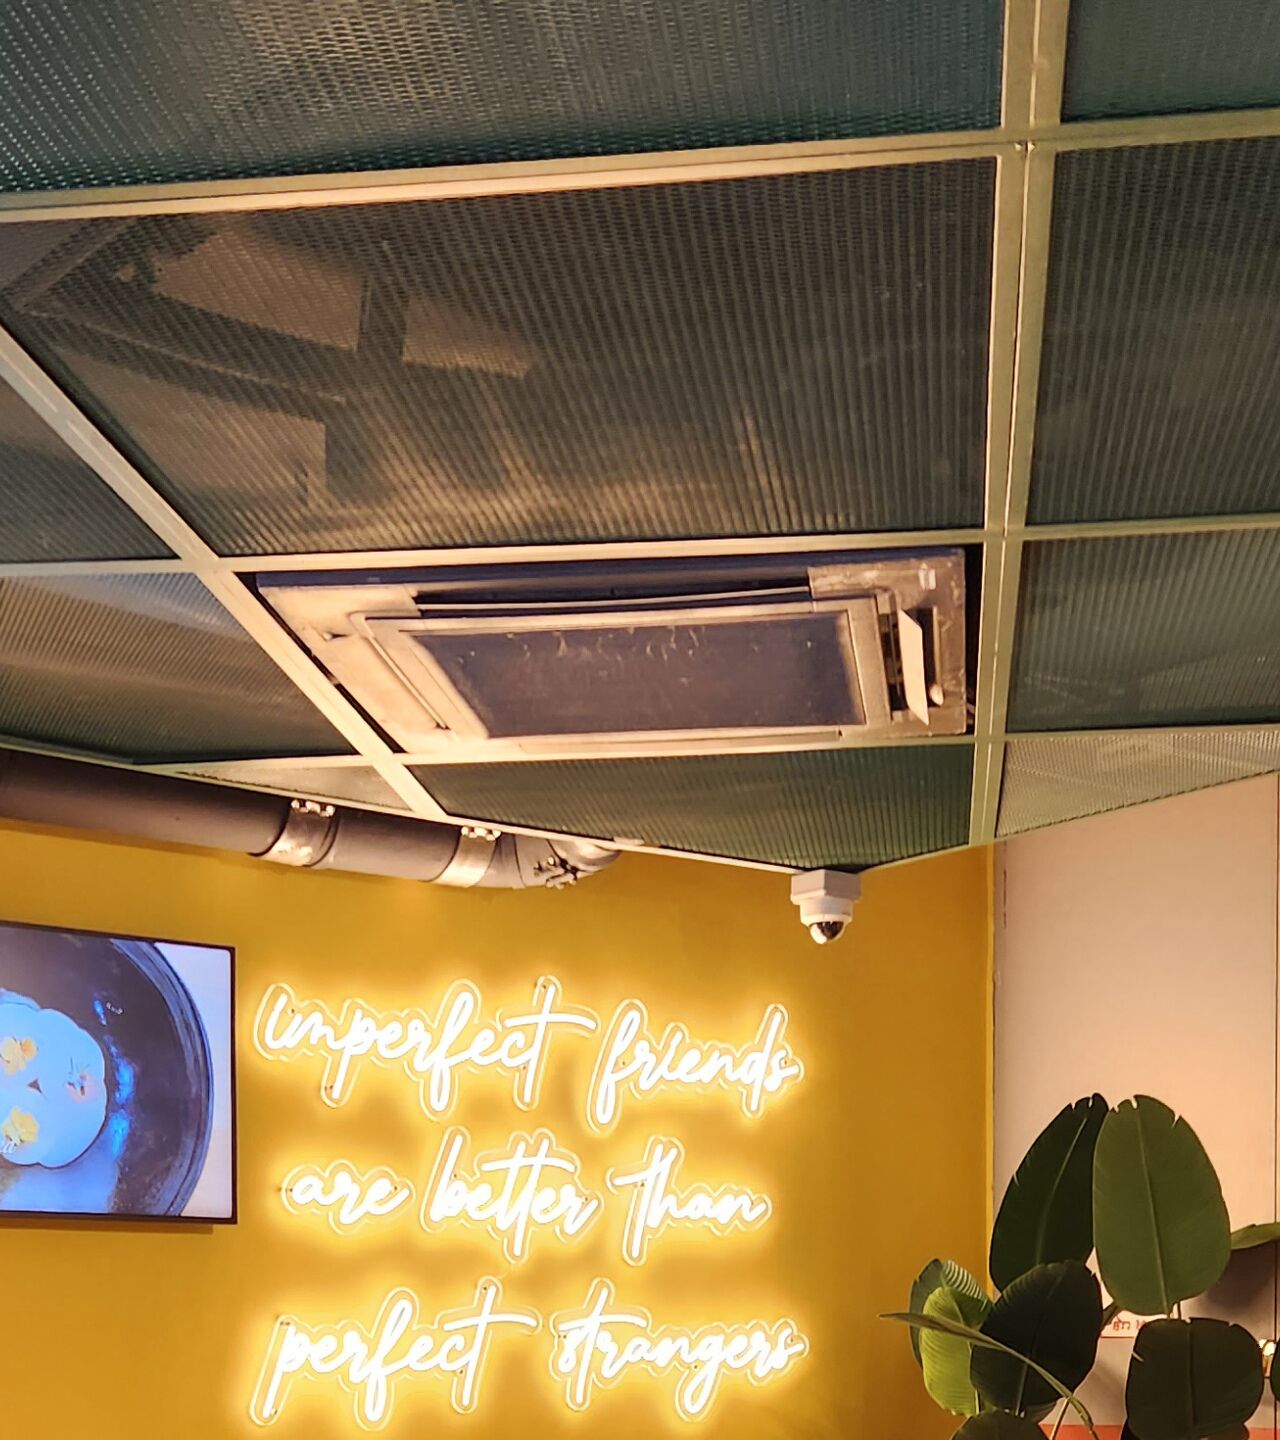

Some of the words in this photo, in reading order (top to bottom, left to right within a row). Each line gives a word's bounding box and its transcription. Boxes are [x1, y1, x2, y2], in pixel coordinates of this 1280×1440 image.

[263, 980, 597, 1112] imperfect
[594, 1010, 800, 1126] friends
[292, 1172, 410, 1224] are
[429, 1135, 598, 1257] better
[613, 1143, 767, 1259] than
[263, 1284, 538, 1422] perfect
[555, 1287, 805, 1416] strangers
